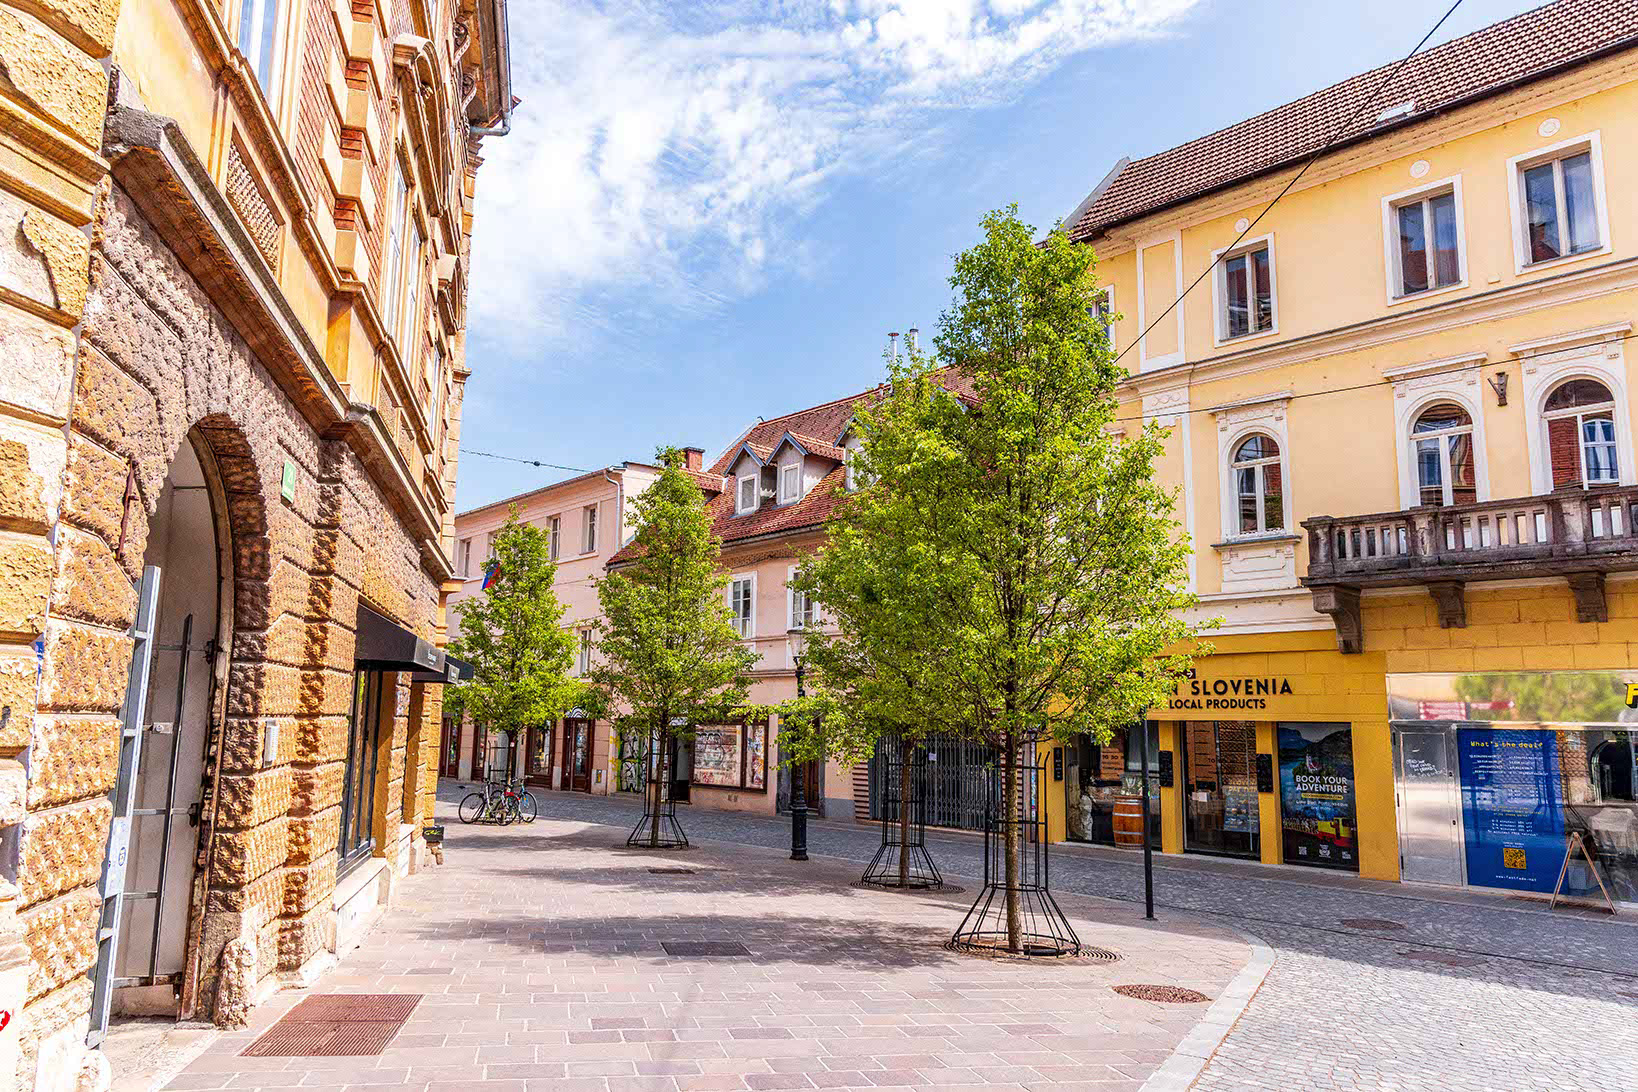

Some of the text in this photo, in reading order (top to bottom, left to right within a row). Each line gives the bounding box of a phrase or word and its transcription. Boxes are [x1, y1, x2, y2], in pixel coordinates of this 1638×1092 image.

[1191, 679, 1293, 695] SLOVENIA
[1169, 699, 1203, 710] LOCAL
[1206, 698, 1266, 710] PRODUCTS
[1501, 741, 1517, 749] the
[1296, 775, 1348, 784] BOOK YOUR
[1296, 783, 1348, 794] ADVENTURE
